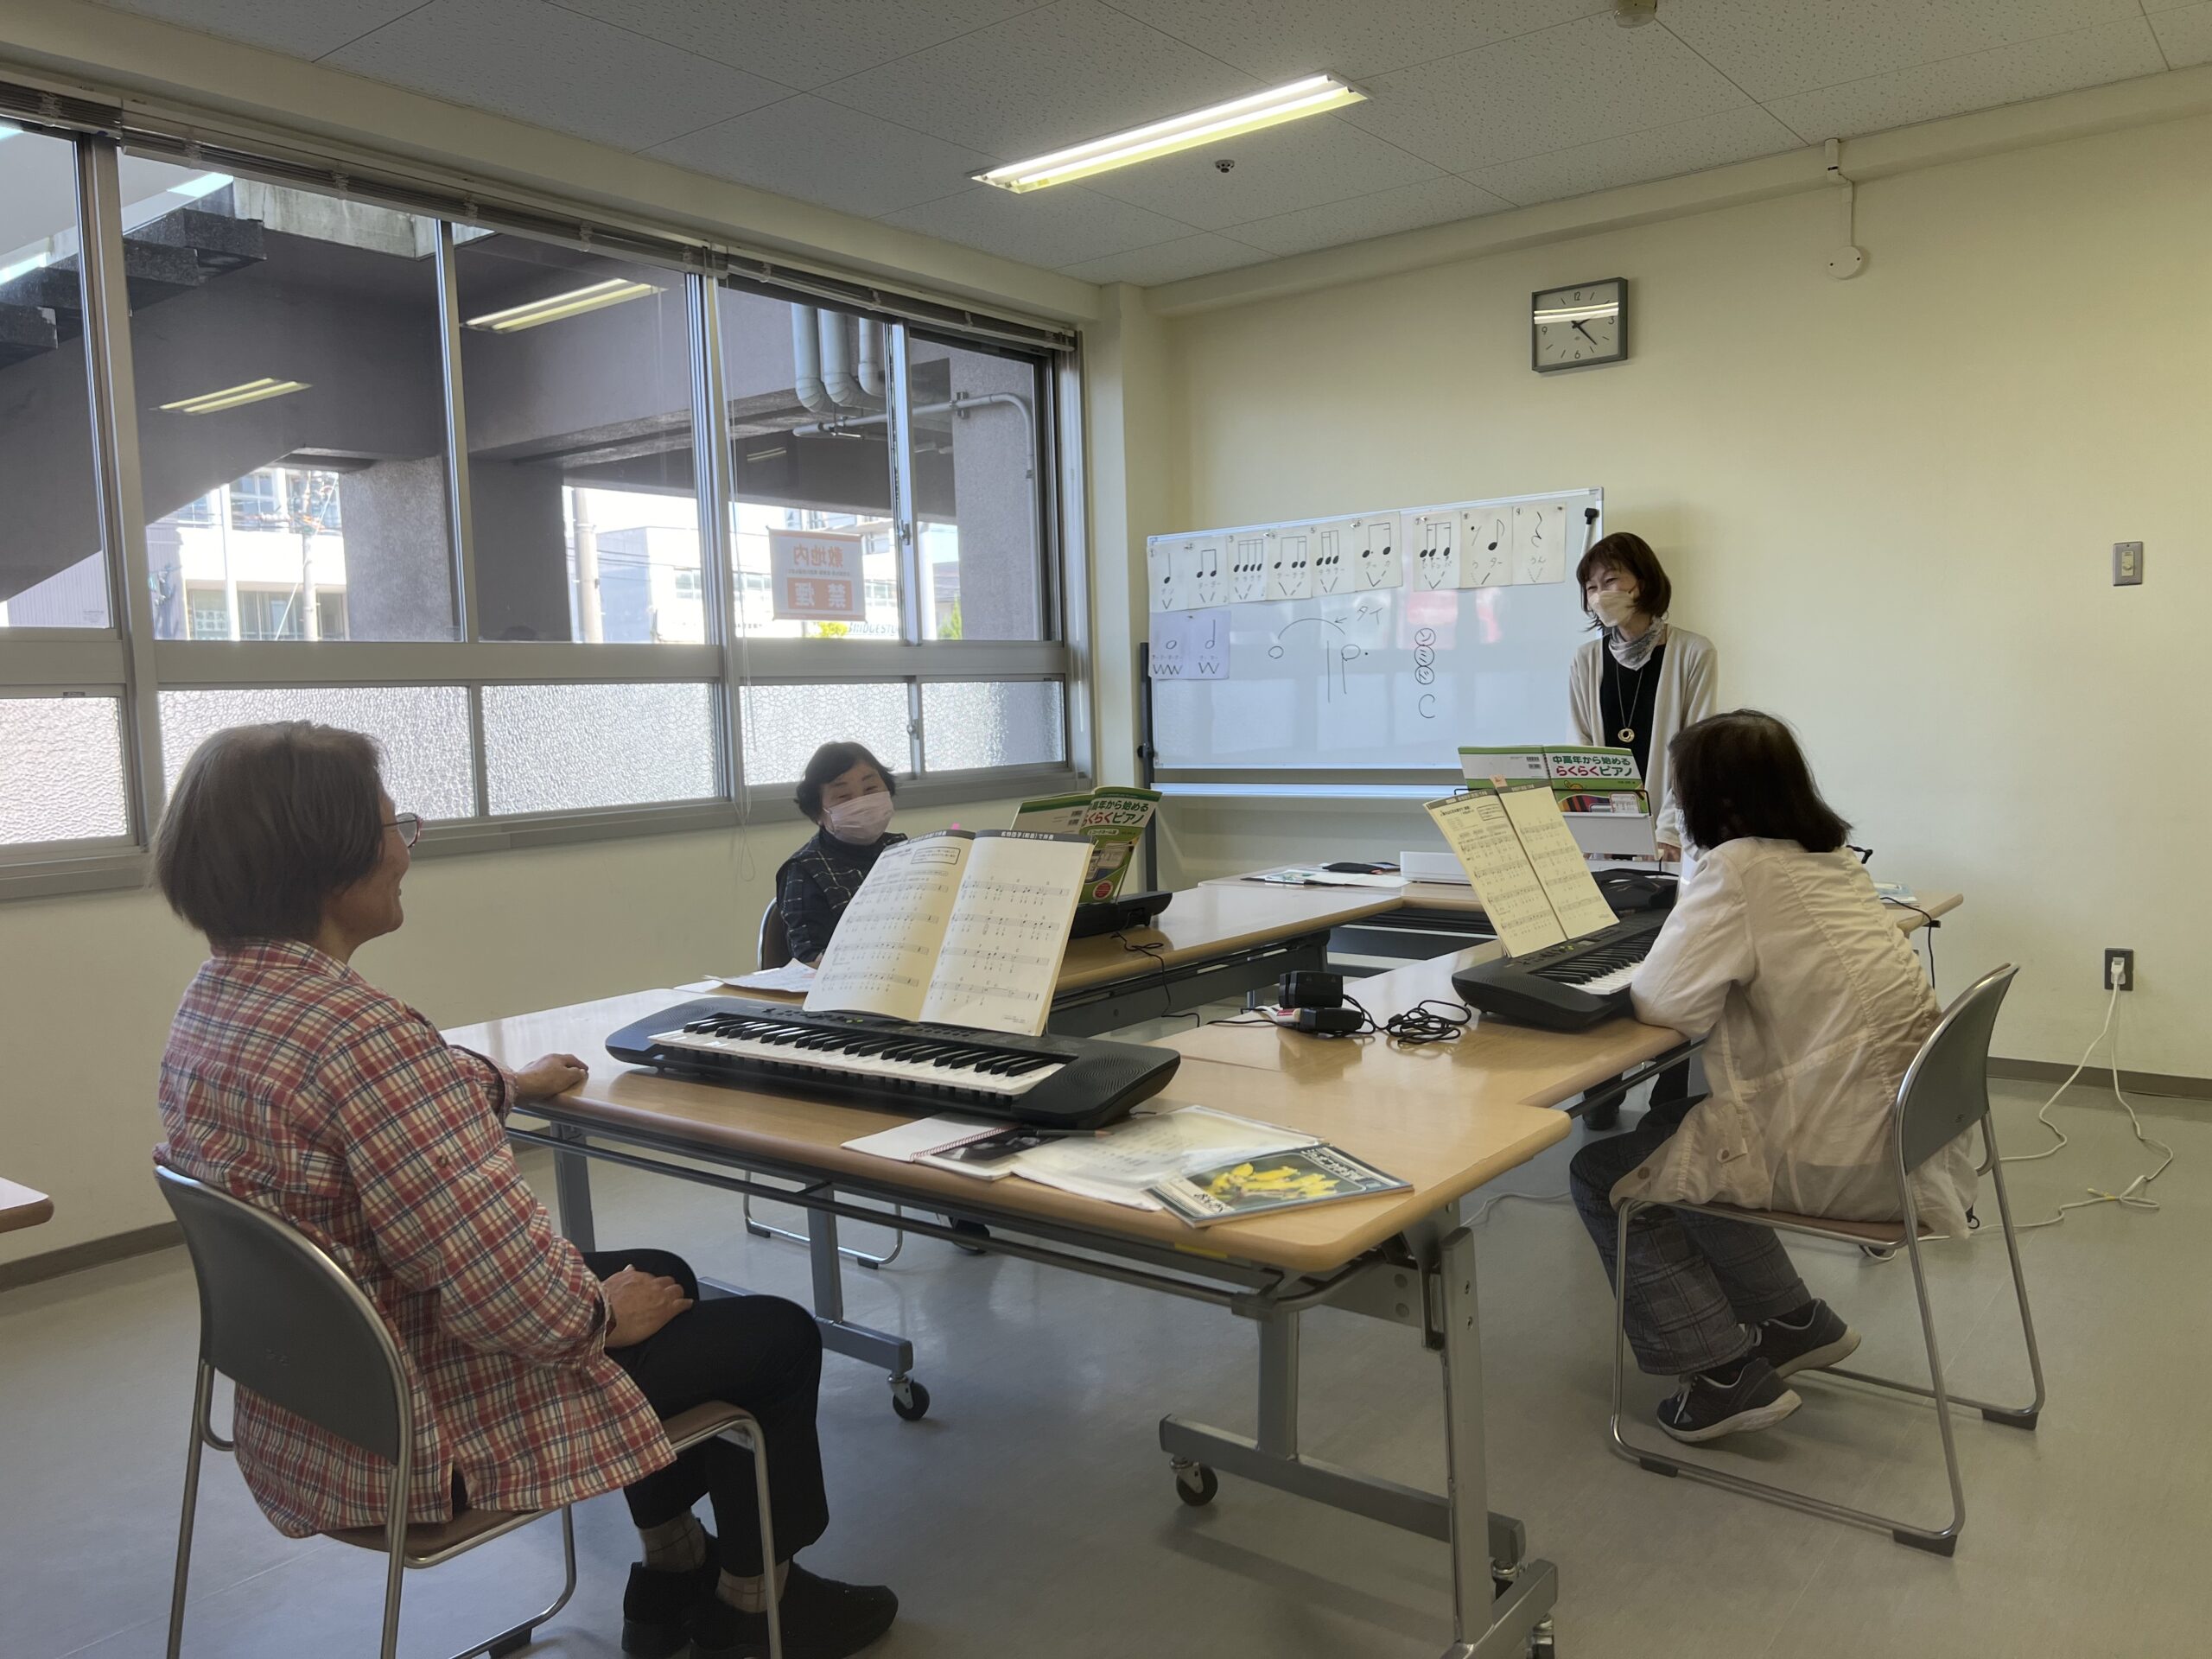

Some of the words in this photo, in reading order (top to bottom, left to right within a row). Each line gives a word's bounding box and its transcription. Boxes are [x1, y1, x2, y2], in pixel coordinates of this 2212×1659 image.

[1573, 291, 1581, 302] 12
[1607, 315, 1615, 325] 3
[1541, 326, 1548, 335] 9
[1574, 350, 1581, 359] 6
[1357, 605, 1383, 626] タイ
[1552, 754, 1631, 766] 中高年から始める
[1555, 765, 1633, 777] らくらくピアノ
